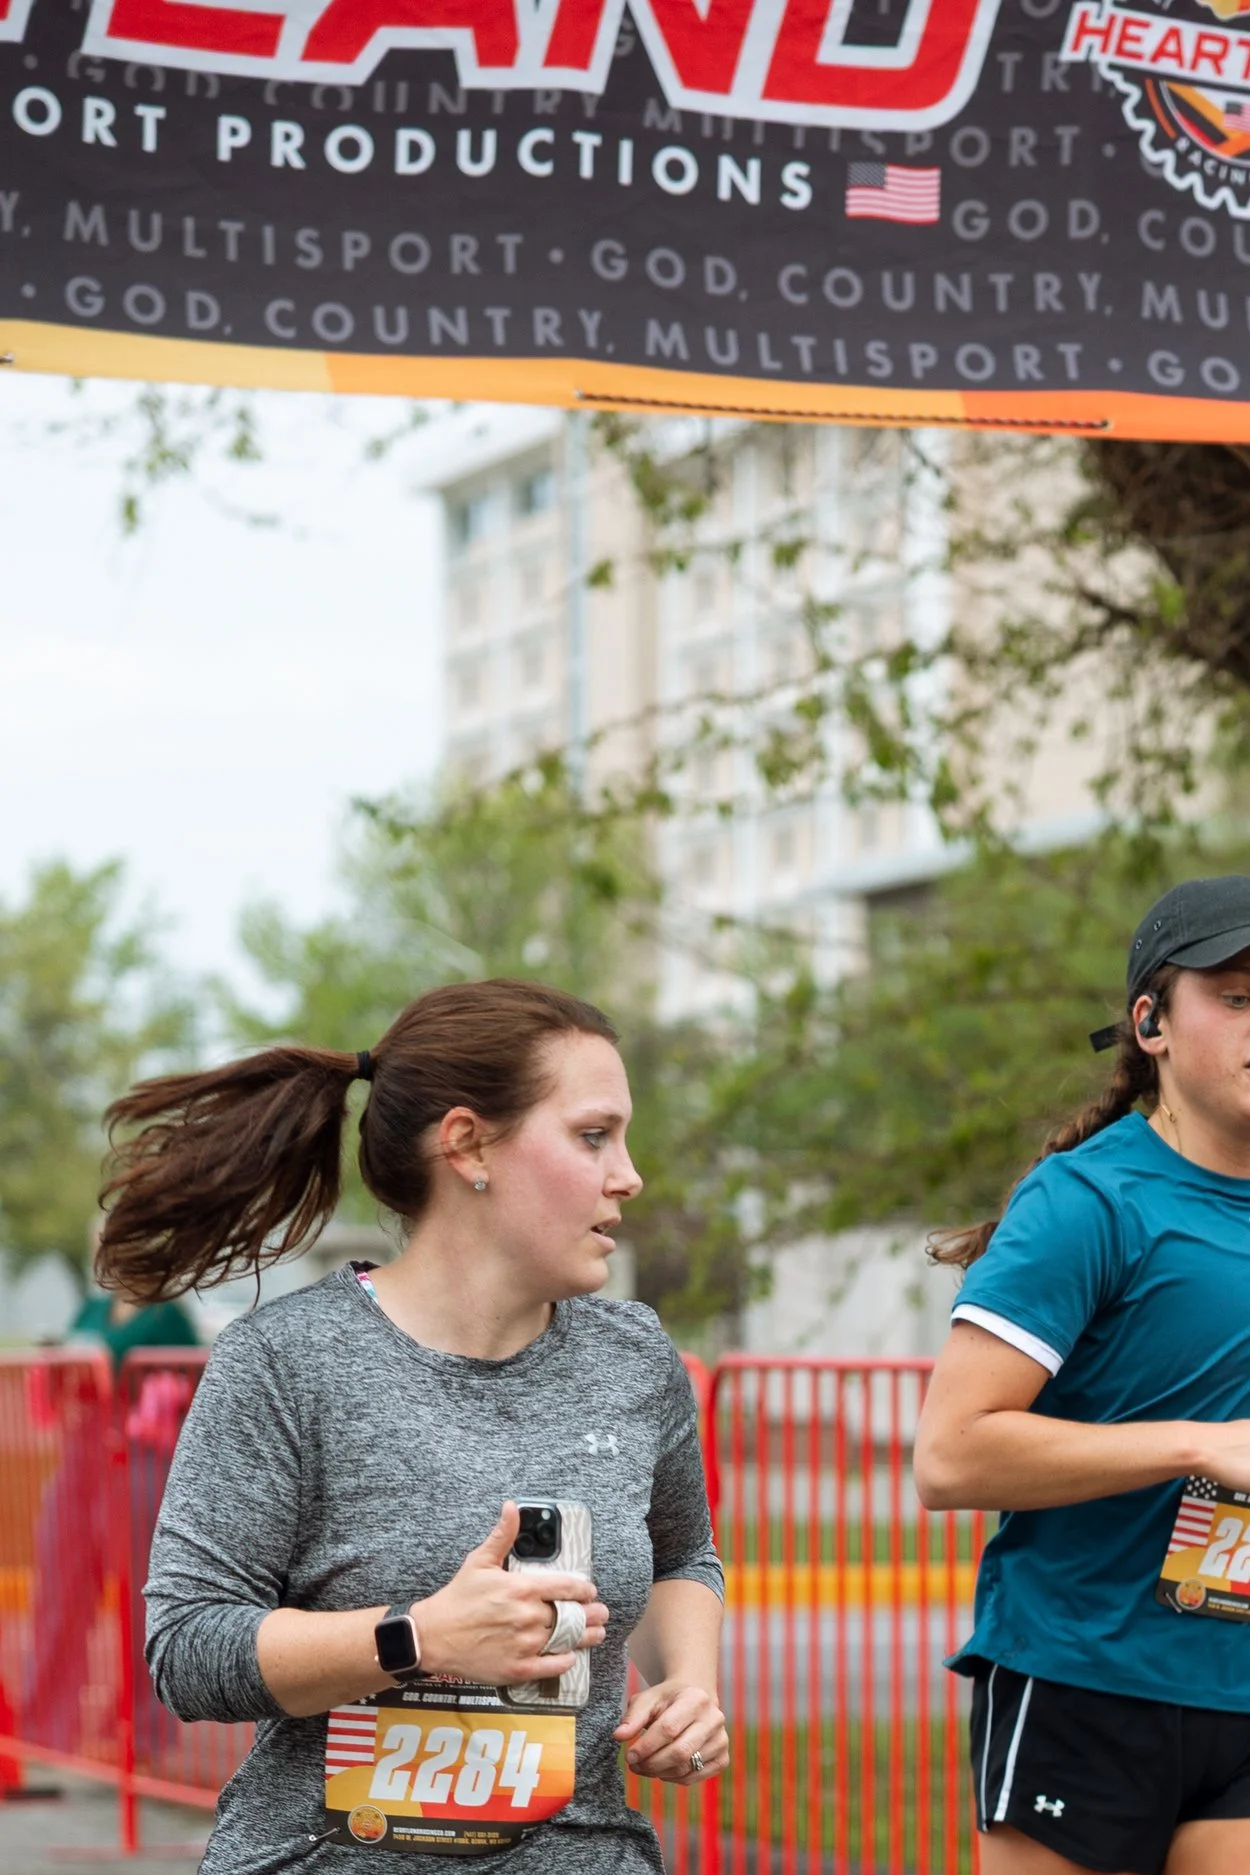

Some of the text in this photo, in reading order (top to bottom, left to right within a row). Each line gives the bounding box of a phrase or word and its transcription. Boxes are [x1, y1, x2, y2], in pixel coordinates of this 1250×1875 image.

[0, 0, 1001, 131] LAND
[12, 86, 813, 211] ORT PRODUCTIONS
[63, 200, 524, 276] MULTISPORT
[645, 317, 1082, 381] MULTISPORT
[367, 1724, 544, 1808] 2284
